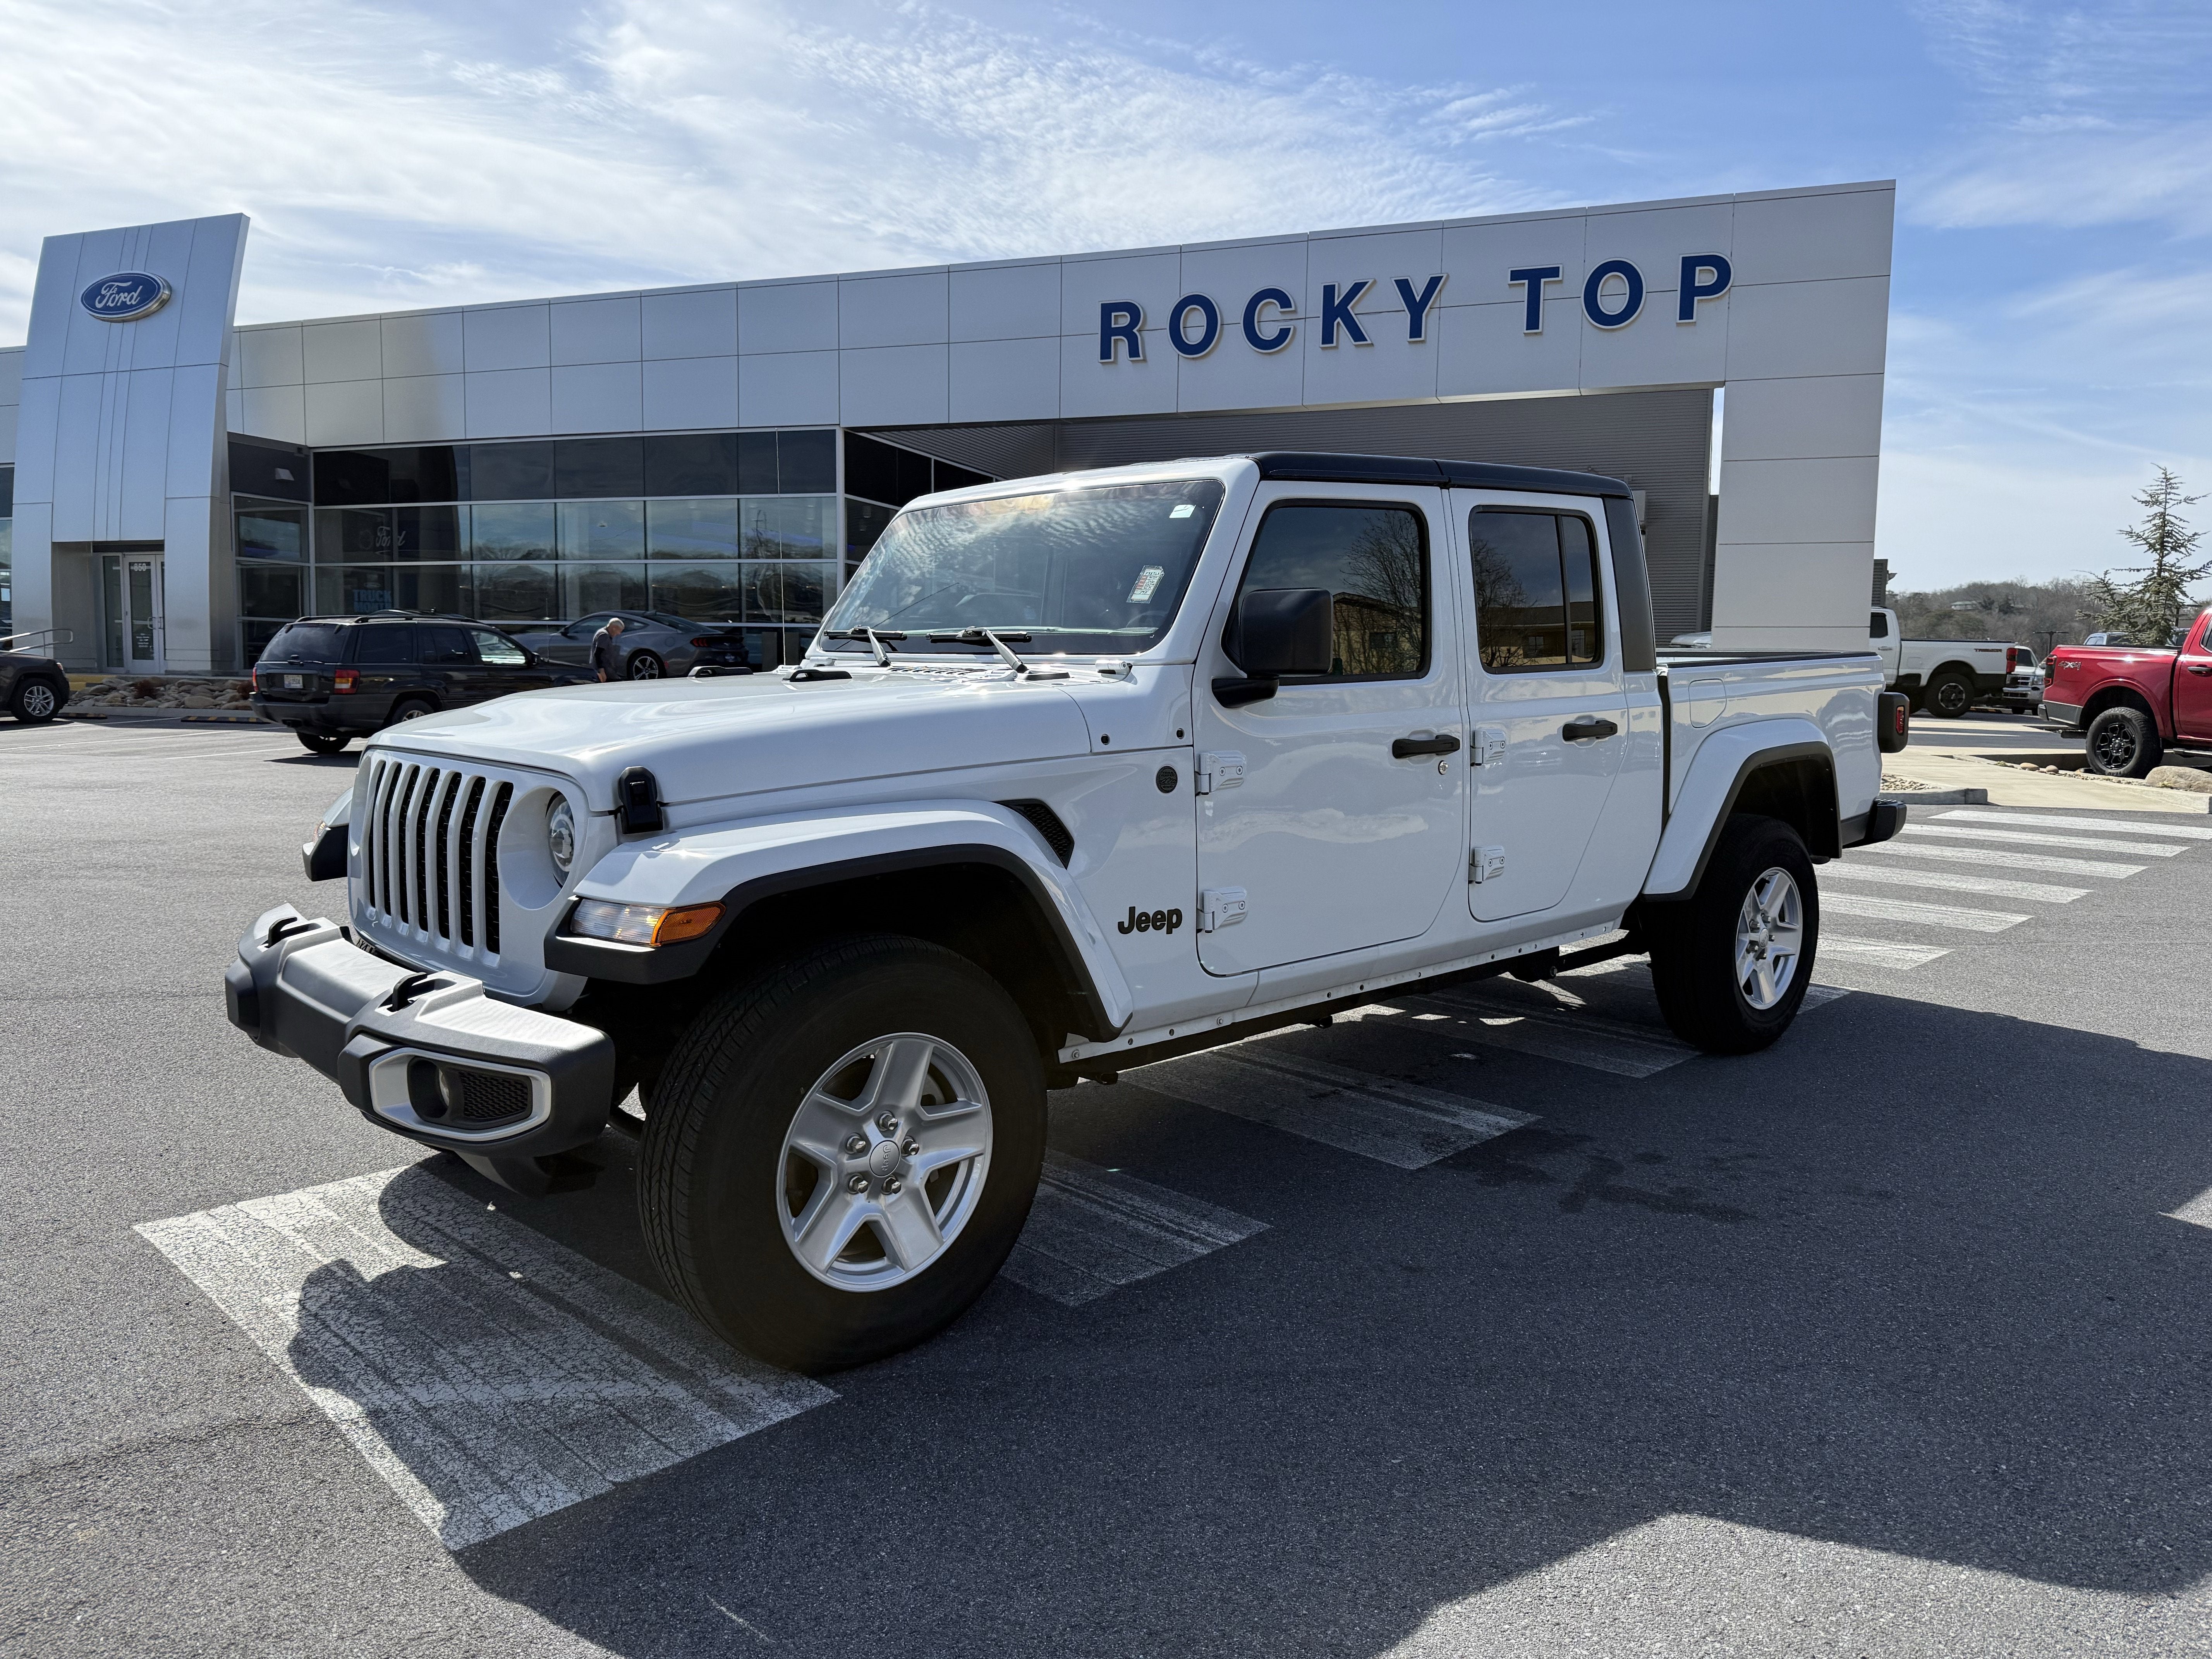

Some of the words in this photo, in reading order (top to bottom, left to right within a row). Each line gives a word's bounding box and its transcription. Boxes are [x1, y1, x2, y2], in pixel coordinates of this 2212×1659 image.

[95, 281, 143, 308] Ford
[1098, 273, 1448, 364] ROCKY
[1508, 252, 1733, 334] TOP
[1118, 906, 1183, 934] Jeep
[881, 1145, 891, 1171] Jeep
